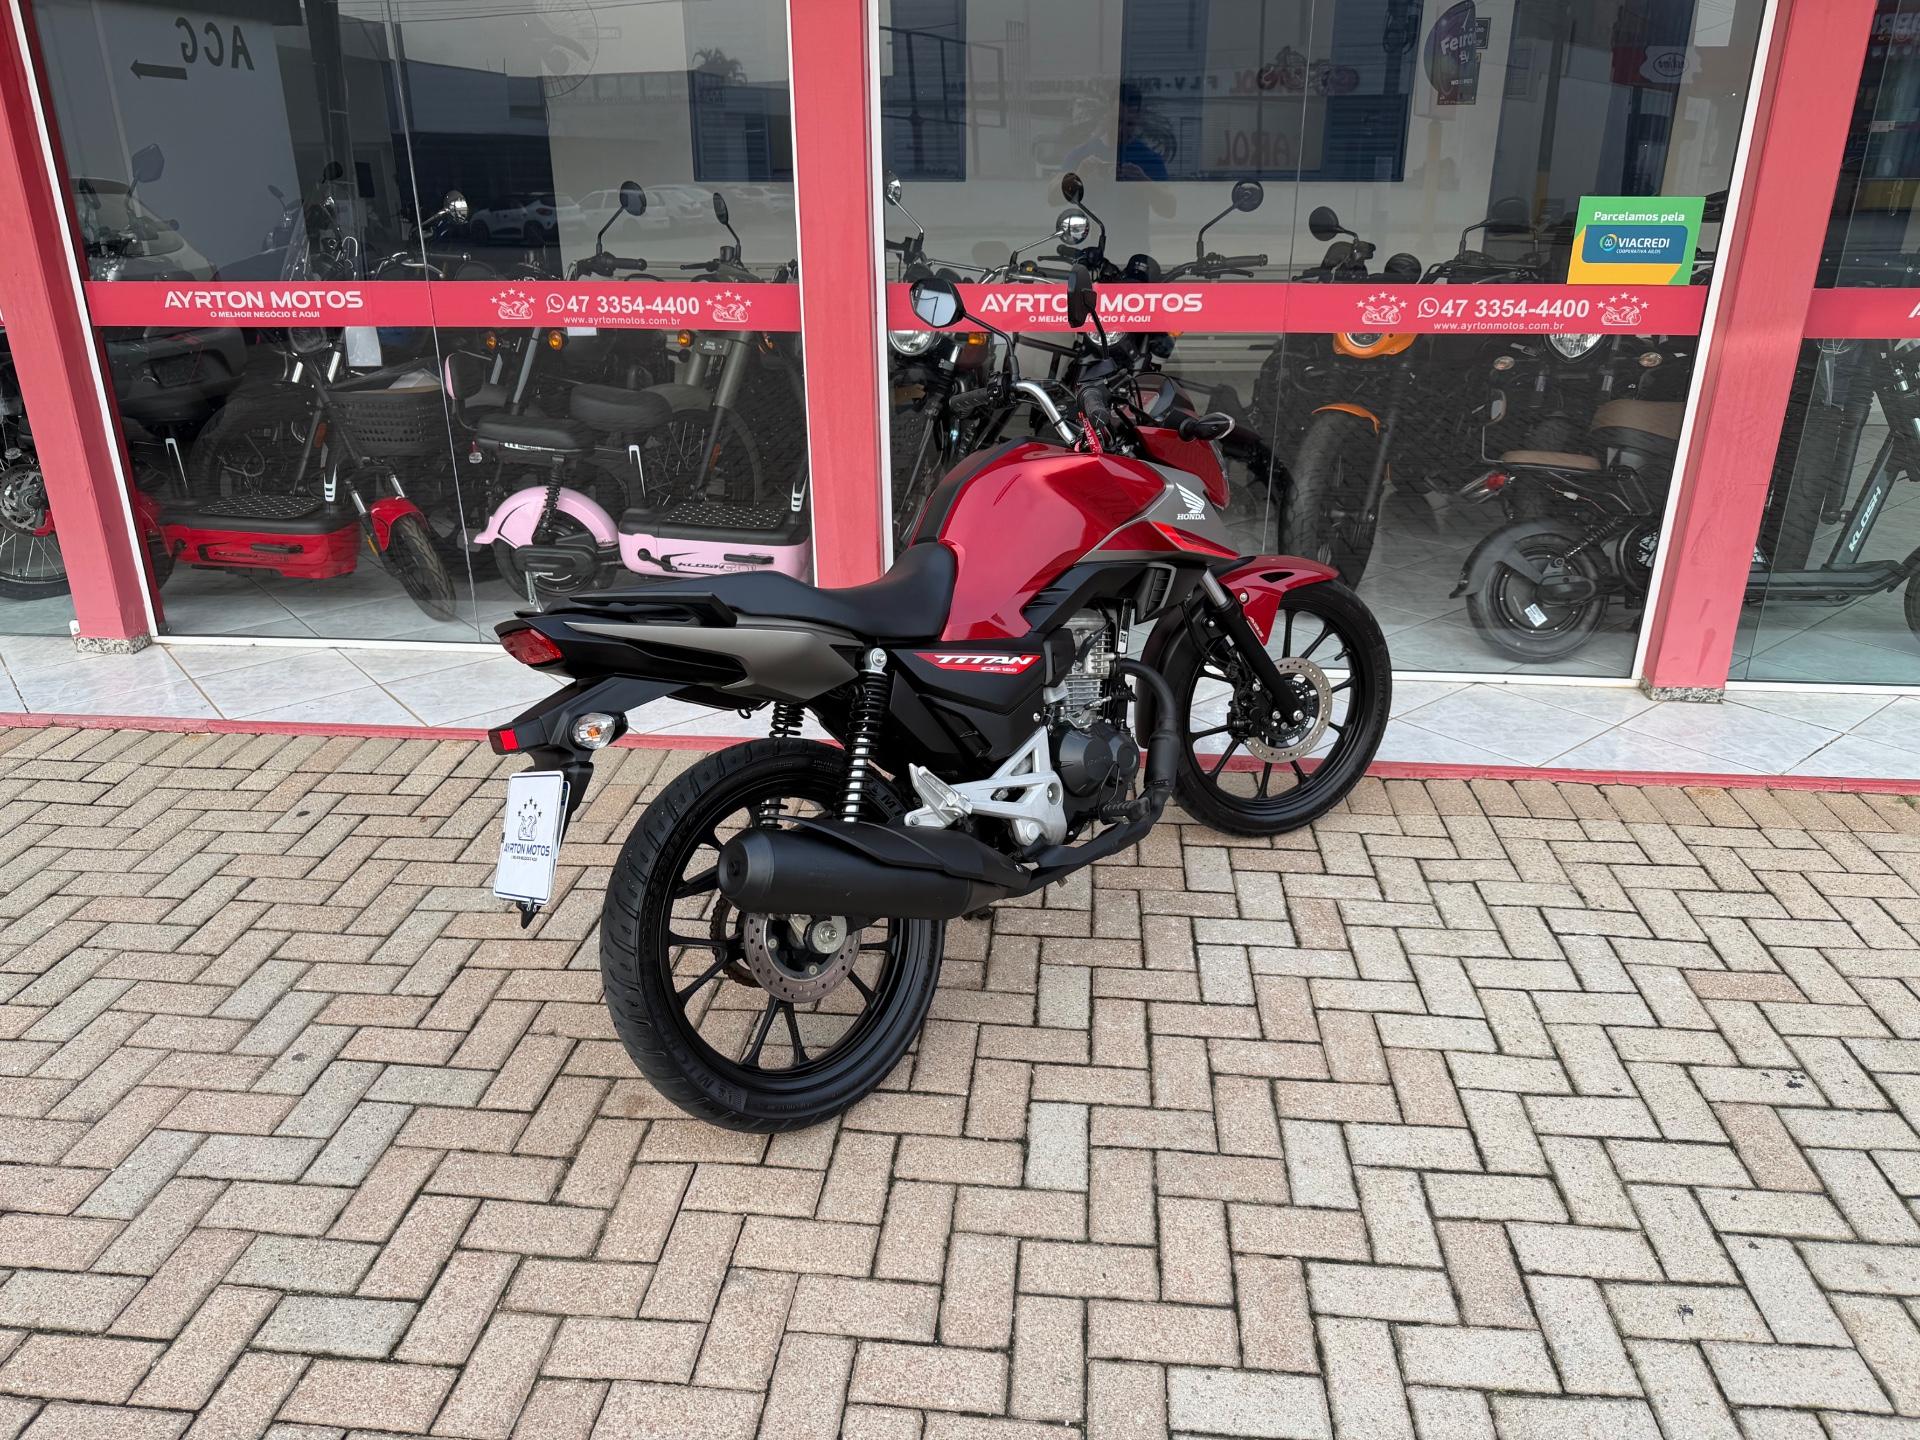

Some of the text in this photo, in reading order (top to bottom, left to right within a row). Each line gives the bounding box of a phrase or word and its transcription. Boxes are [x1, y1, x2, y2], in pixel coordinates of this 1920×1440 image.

[1594, 211, 1685, 223] Parcelamos pela
[1618, 237, 1670, 248] VIACREDI
[164, 290, 364, 309] AYRTON MOTOS
[567, 295, 700, 315] 47 3354-4400
[980, 293, 1203, 313] AYRTO MOTOS
[253, 310, 292, 318] NEGÓCIO
[292, 309, 298, 318] É
[1440, 299, 1590, 318] 47 3354-4400
[563, 315, 681, 326] www.ayrtonmotos.com.br
[1029, 315, 1036, 323] O
[1038, 315, 1068, 323] MELHO
[1120, 313, 1126, 323] É
[1127, 315, 1151, 323] AQUI
[1433, 321, 1564, 332] www.ayrtonmotos.com.br
[1176, 513, 1206, 521] HONDA
[1848, 486, 1882, 552] KLOSH
[934, 654, 1033, 665] TITAN
[504, 842, 550, 857] AYRTON MOTOS
